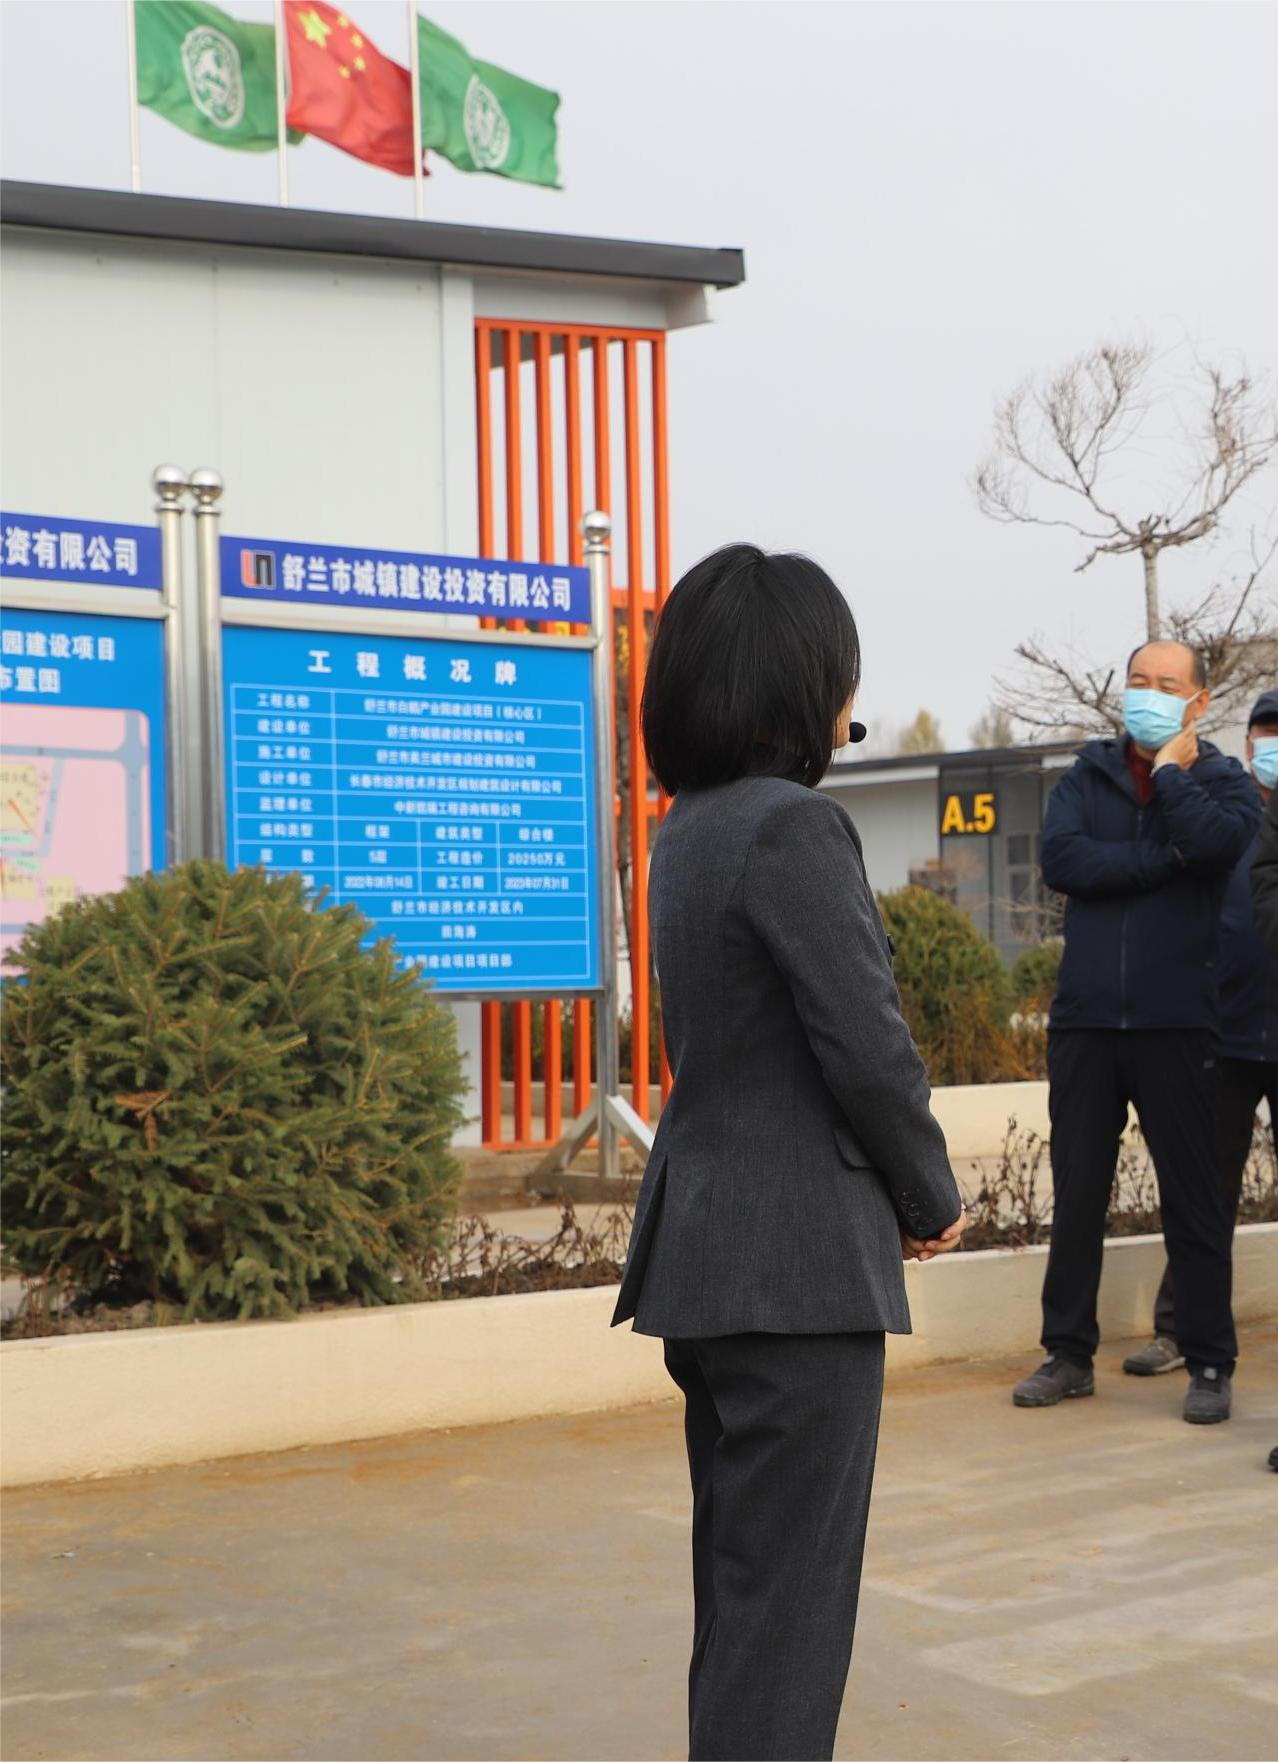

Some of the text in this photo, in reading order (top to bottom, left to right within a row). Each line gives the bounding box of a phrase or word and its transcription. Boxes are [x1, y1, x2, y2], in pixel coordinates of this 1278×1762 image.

[0, 526, 138, 576] 资有限公司
[282, 553, 572, 612] 舒兰市城镇建设投资有限公司
[0, 628, 115, 661] 园建设项目
[257, 693, 311, 709] 工程名称
[257, 718, 311, 735] 建设单位
[941, 793, 996, 833] A.5
[398, 953, 513, 969] 业园建设项目项目部
